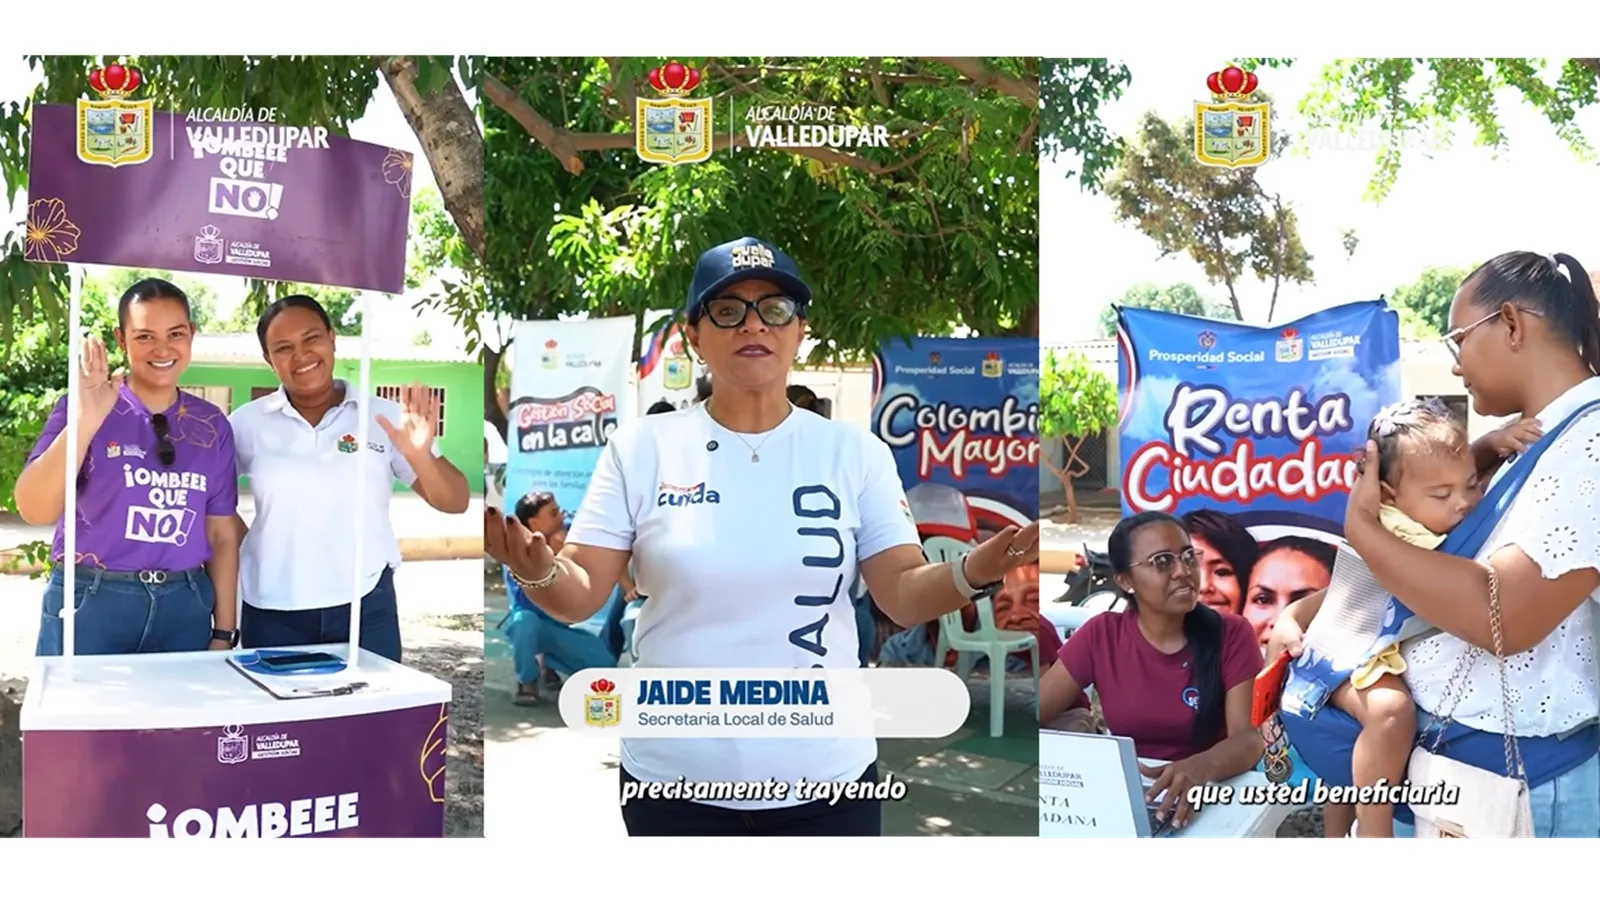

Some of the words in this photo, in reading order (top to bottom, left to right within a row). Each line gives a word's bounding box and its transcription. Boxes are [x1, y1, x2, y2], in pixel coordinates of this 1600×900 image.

[220, 156, 264, 179] QUE
[212, 180, 284, 219] NO!
[895, 365, 947, 376] Prosperidad
[949, 366, 975, 375] Social
[1149, 349, 1224, 364] Prosperidad
[1227, 351, 1265, 363] Social
[521, 431, 545, 451] en
[548, 423, 568, 448] la
[571, 420, 617, 447] calle
[879, 395, 1039, 447] Colombi
[1168, 386, 1350, 457] Renta
[920, 428, 1039, 477] Mayor
[123, 463, 208, 492] ¡OMBEEE
[148, 487, 189, 509] QUE
[128, 507, 198, 547] NO!
[788, 484, 844, 668] ALUD
[256, 740, 300, 750] VALLEDUPAR
[146, 792, 359, 838] ¡OMBEEE
[1040, 812, 1097, 828] ADANA
